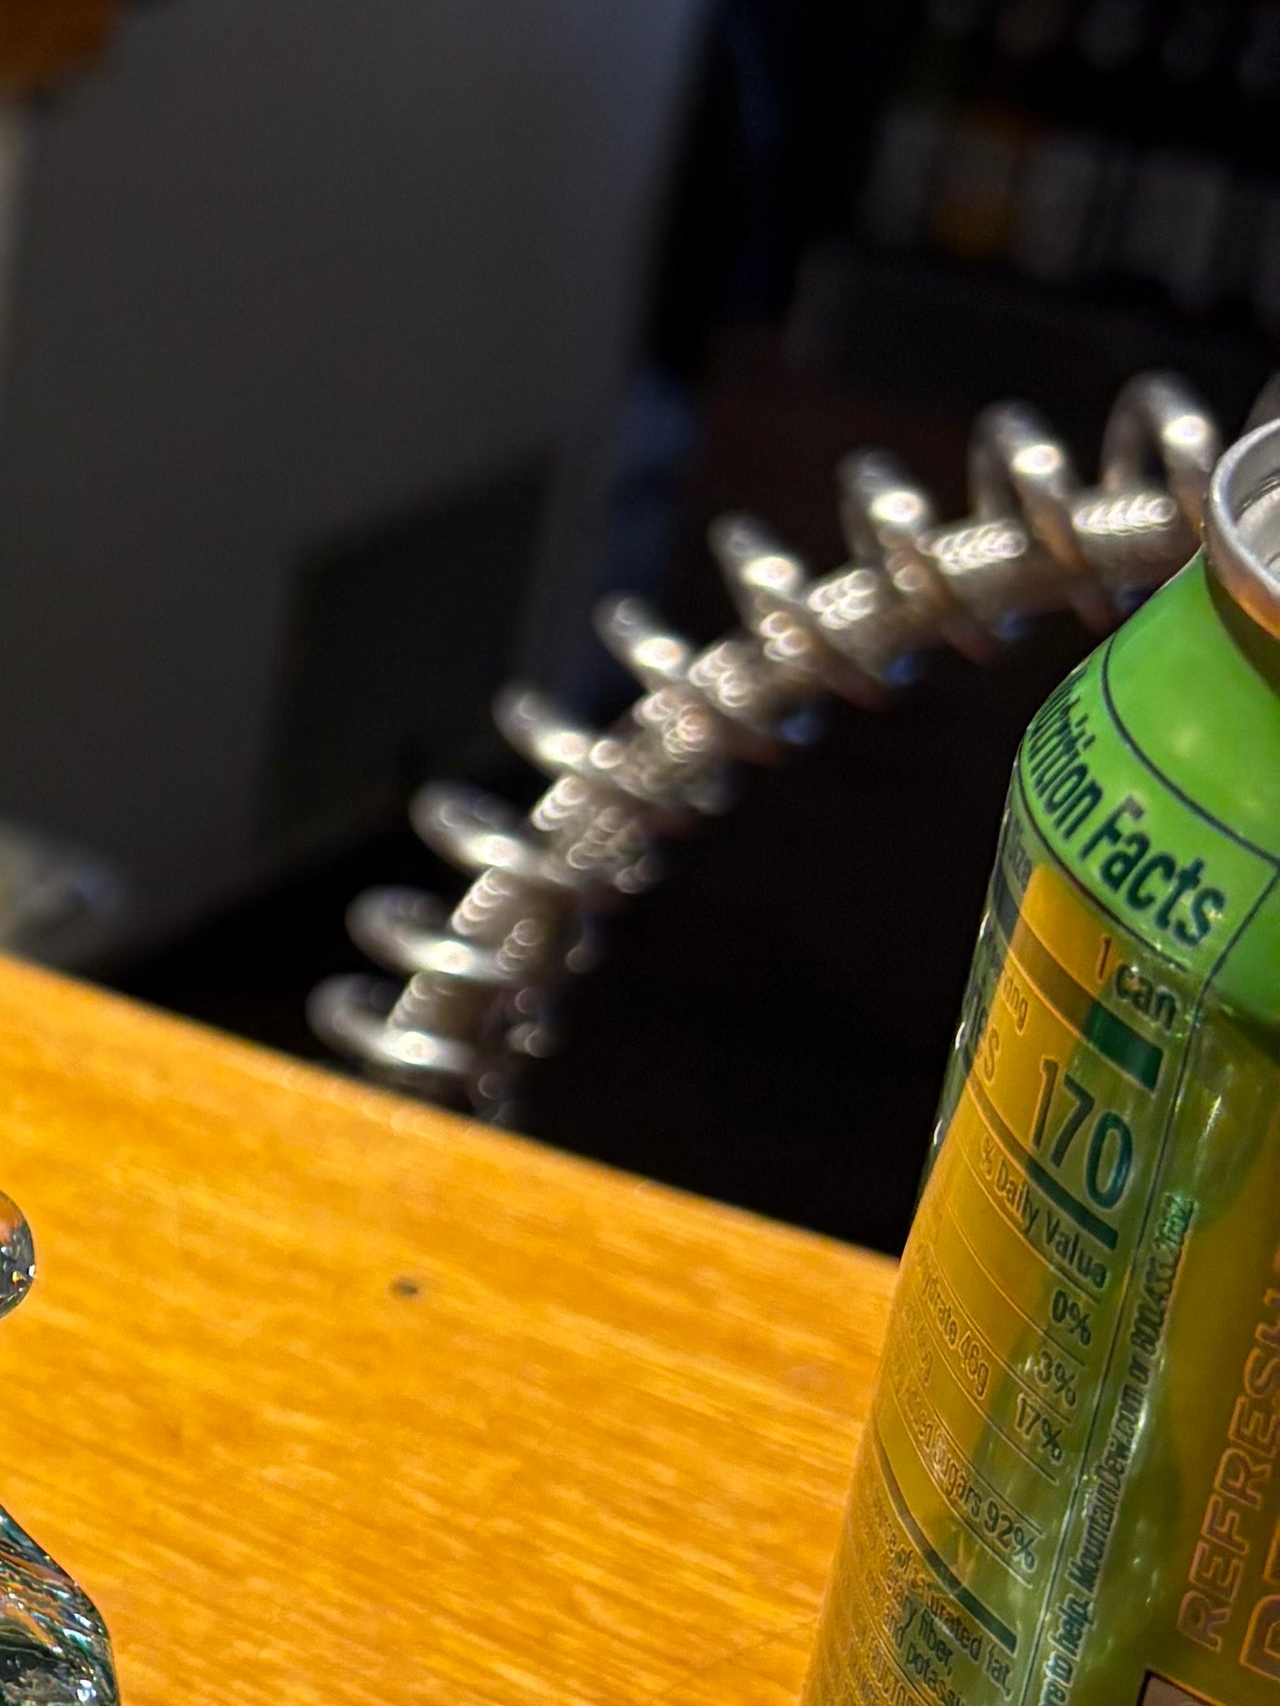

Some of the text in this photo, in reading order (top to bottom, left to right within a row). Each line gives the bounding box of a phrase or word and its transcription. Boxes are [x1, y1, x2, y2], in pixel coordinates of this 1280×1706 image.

[1078, 795, 1225, 945] Facts
[1113, 961, 1178, 1031] can
[1030, 1058, 1133, 1210] 170
[995, 1158, 1039, 1234] Daily
[1051, 1288, 1091, 1345] 0%
[1037, 1349, 1077, 1407] 3%
[1017, 1393, 1063, 1464] 17%
[983, 1499, 1037, 1571] 92%
[1045, 1651, 1073, 1689] to
